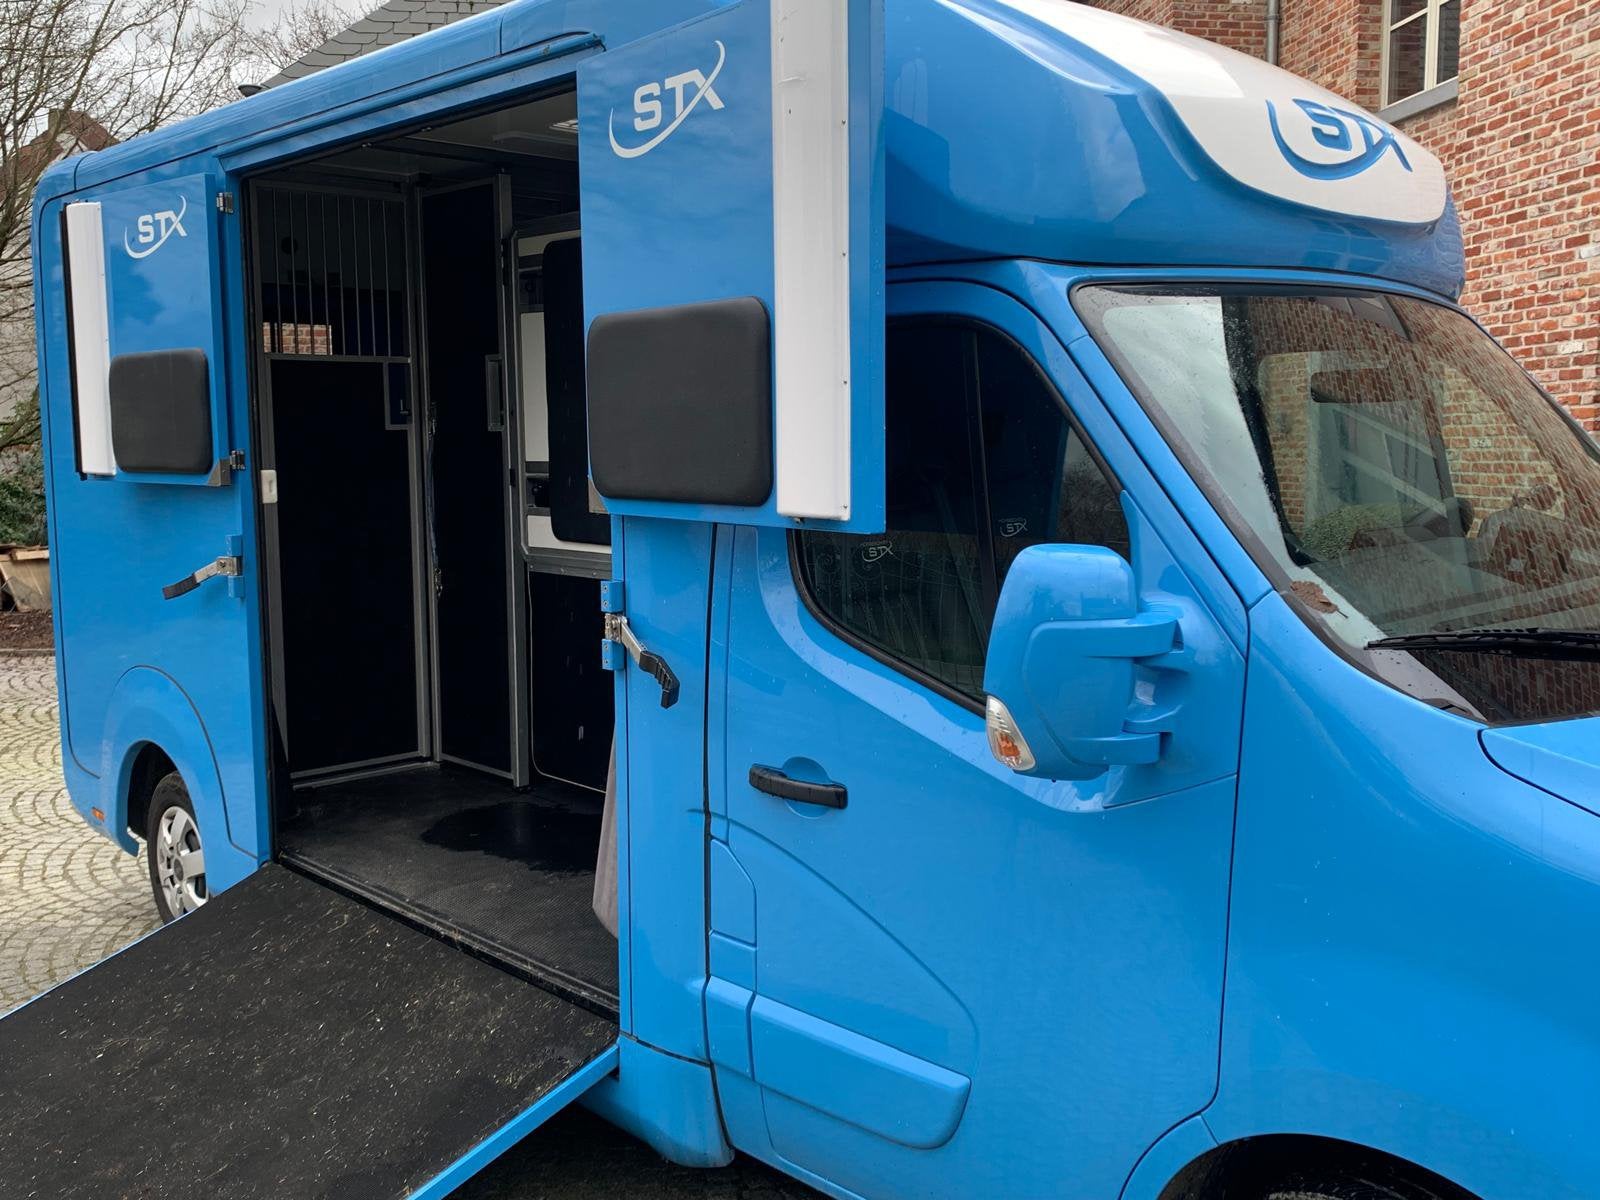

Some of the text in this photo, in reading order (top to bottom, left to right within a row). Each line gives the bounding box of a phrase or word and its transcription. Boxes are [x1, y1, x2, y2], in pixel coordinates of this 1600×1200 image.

[633, 68, 725, 132] STX
[1292, 98, 1413, 172] STX
[138, 210, 187, 243] STX
